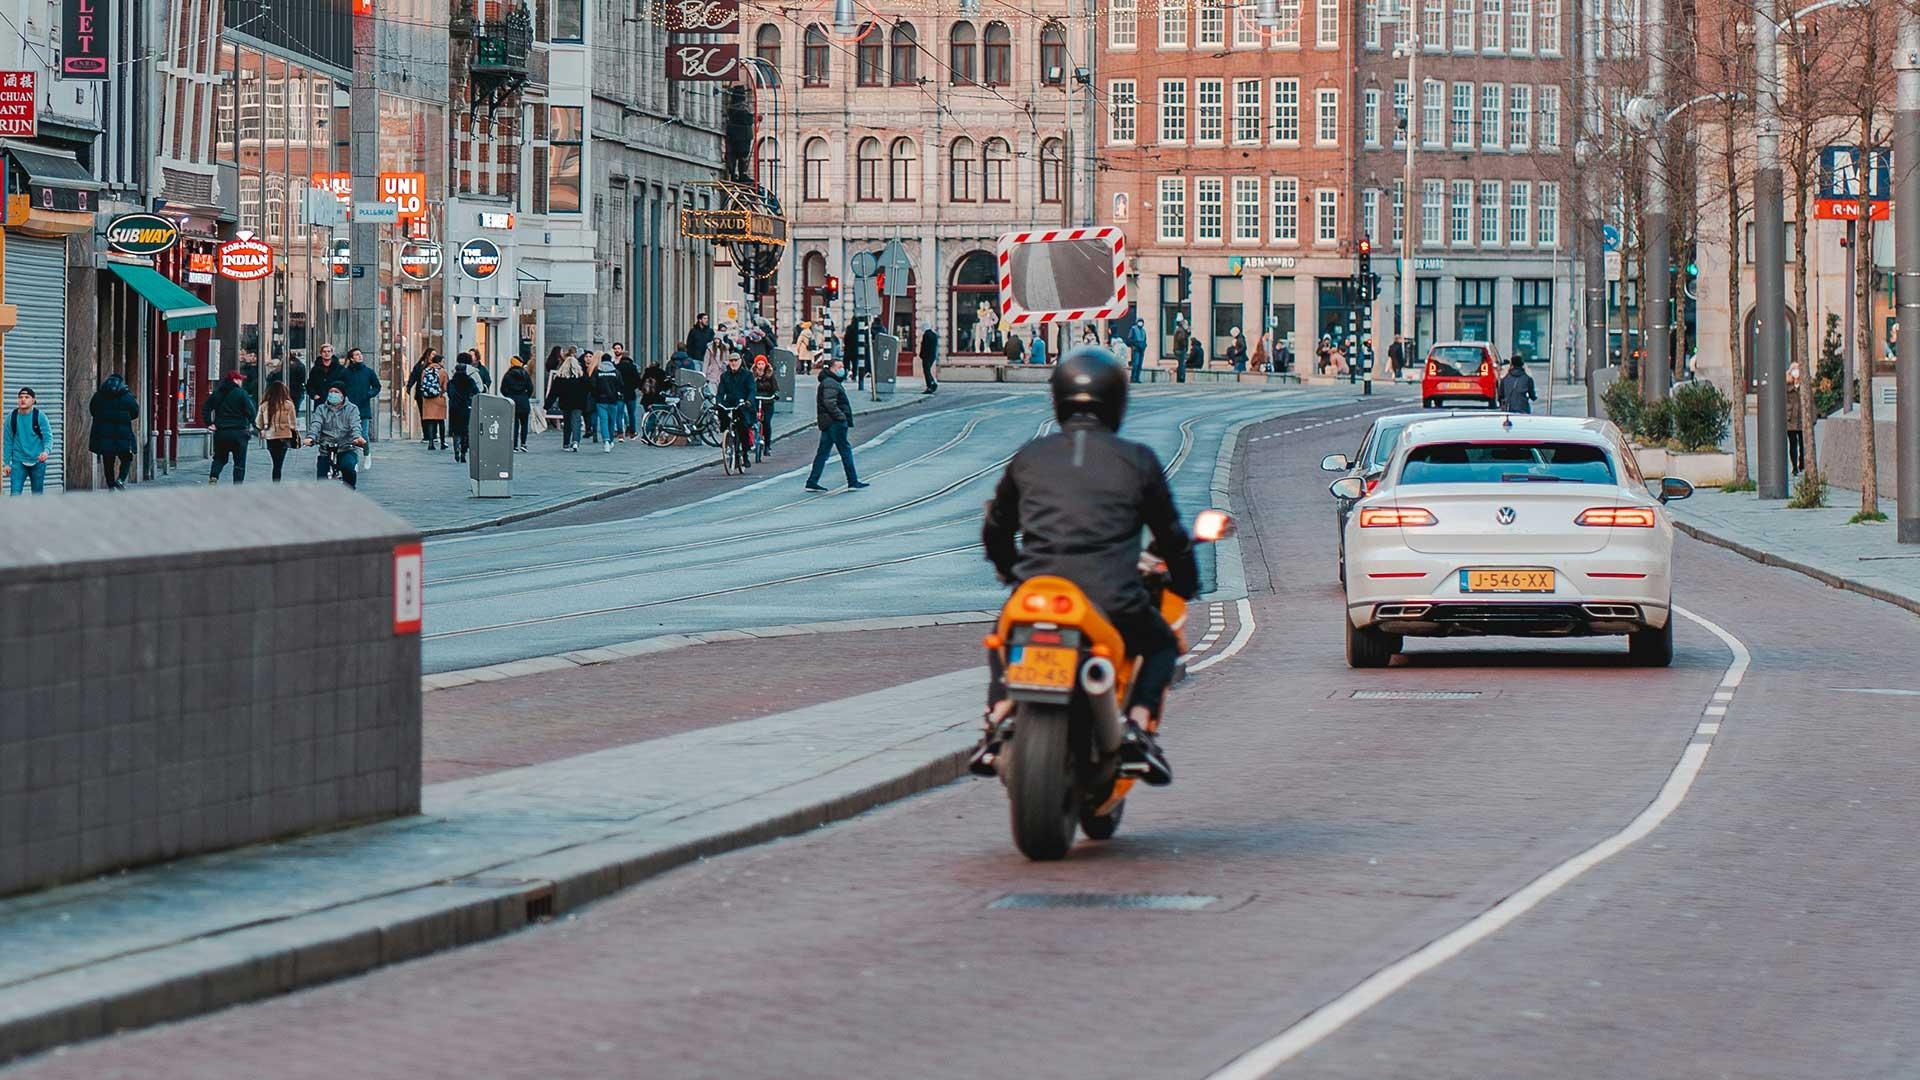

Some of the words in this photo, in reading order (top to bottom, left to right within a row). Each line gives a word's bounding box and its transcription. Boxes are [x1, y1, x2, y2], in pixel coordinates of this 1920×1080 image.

[384, 178, 418, 194] UNI
[359, 208, 394, 216] PULL&BEAR
[109, 227, 177, 244] SUBWAY
[221, 254, 269, 266] INDIAN
[463, 256, 498, 264] BAKERY
[1244, 257, 1264, 267] ABN
[222, 266, 269, 278] RESTAURANT
[1475, 574, 1547, 587] J-546-XX
